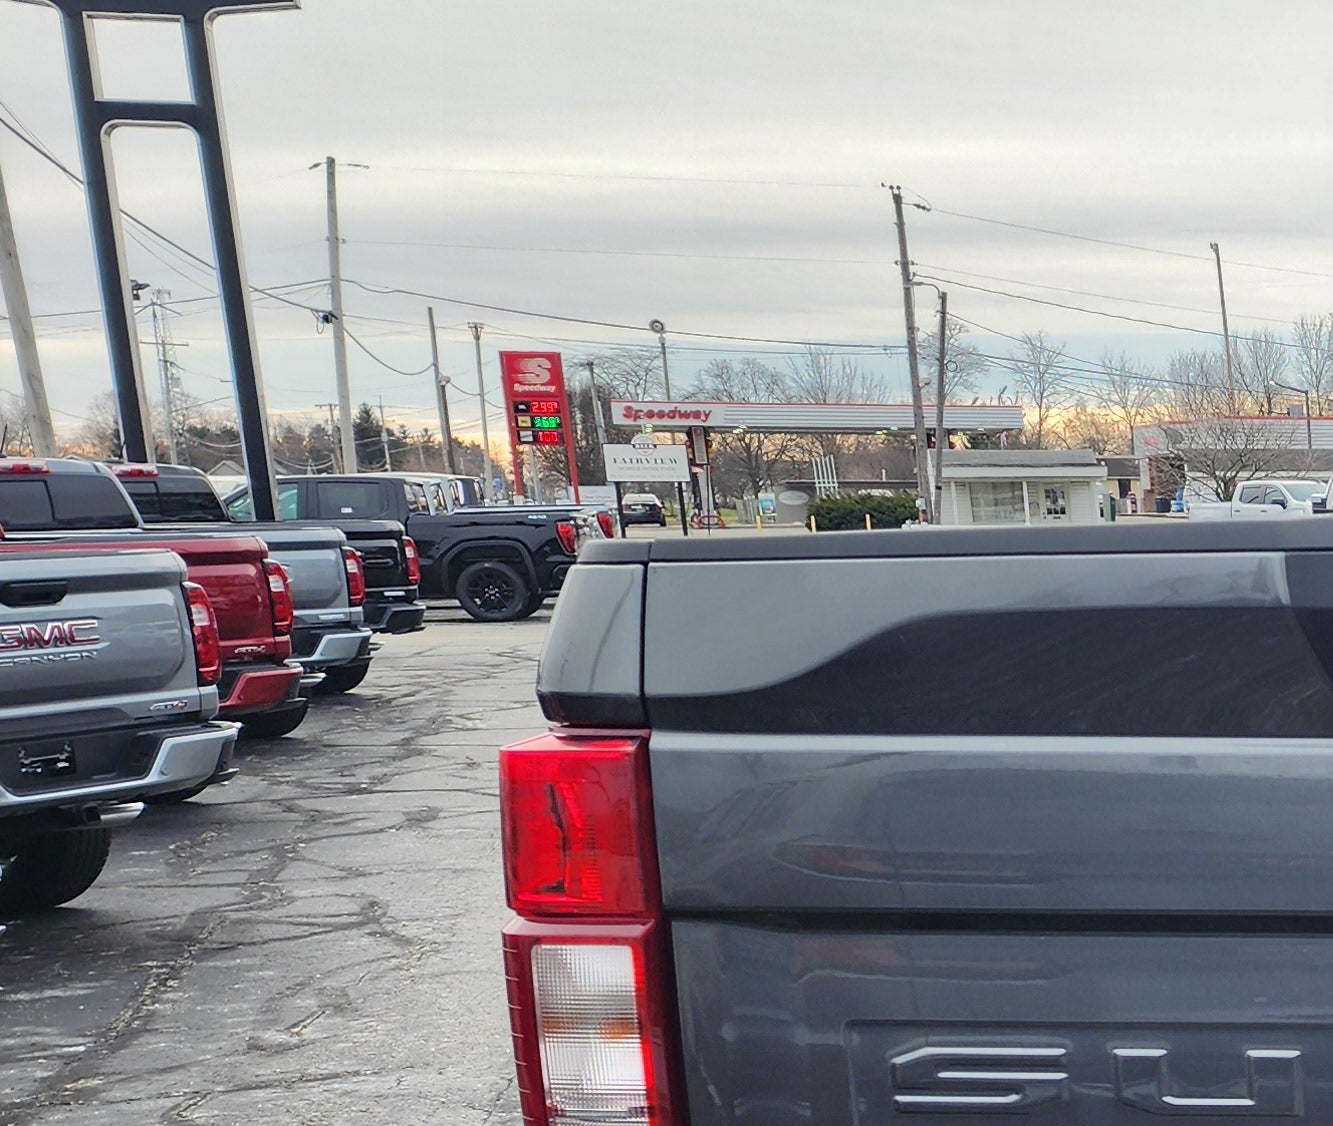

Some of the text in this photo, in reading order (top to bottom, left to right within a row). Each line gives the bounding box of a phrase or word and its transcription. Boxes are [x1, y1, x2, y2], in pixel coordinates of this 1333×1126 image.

[513, 383, 556, 393] Speedway
[623, 405, 711, 423] Speedway
[612, 456, 678, 465] FAIRVIEW
